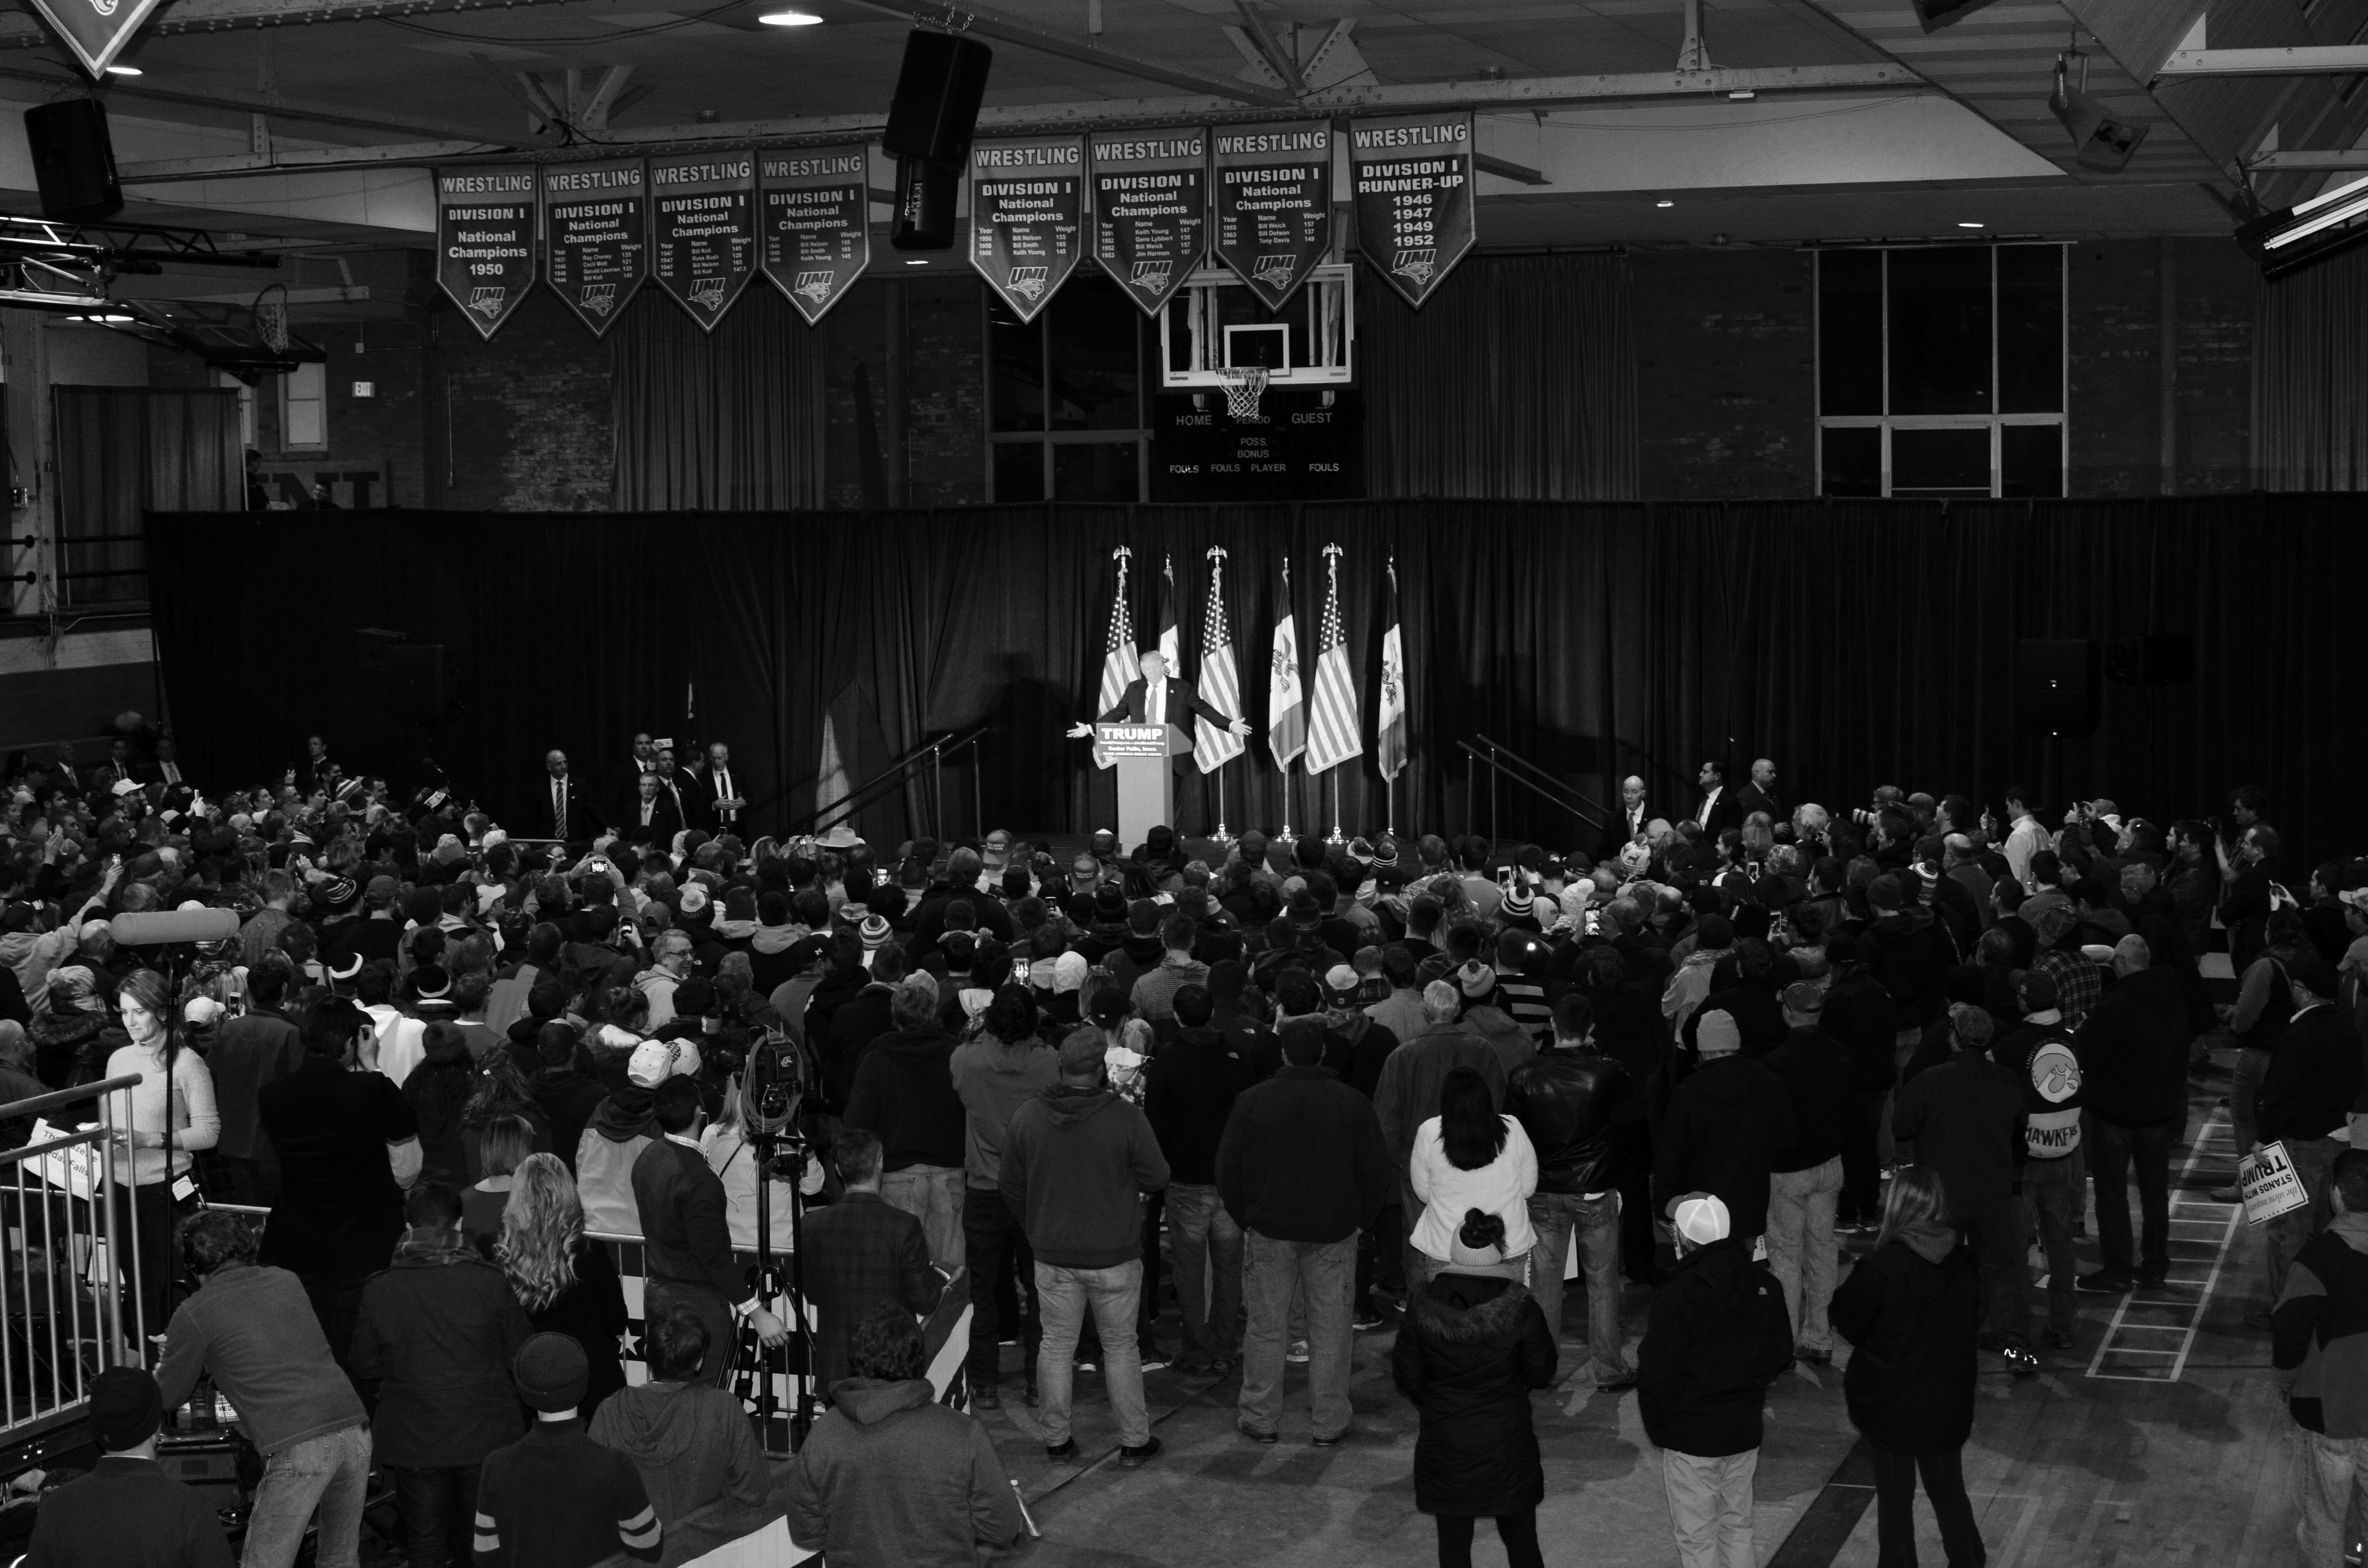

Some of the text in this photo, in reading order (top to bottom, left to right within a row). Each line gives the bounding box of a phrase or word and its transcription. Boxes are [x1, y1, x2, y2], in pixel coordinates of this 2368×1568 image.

[1217, 131, 1326, 154] WRESTLING
[1355, 124, 1466, 148] WRESTLING
[975, 147, 1079, 167] WRESTLING
[1095, 139, 1202, 161] WRESTLING
[654, 161, 751, 184] WRESTLING
[764, 156, 862, 177] WRESTLING
[1363, 159, 1457, 177] DIVISION I
[547, 169, 640, 191] WRESTLING
[1101, 174, 1195, 190] DIVISION I
[1225, 167, 1319, 184] DIVISION I
[442, 176, 531, 192] WRESTLING
[982, 182, 1071, 196] DIVISION I
[1243, 184, 1301, 197] National
[1358, 175, 1464, 193] RUNNER-UP
[662, 195, 744, 212] DIVISION I
[769, 189, 854, 205] DIVISION I
[999, 198, 1054, 209] National
[1120, 191, 1177, 203] National
[1393, 194, 1433, 206] 1946
[555, 202, 634, 219] DIVISION I
[787, 206, 839, 217] National
[1111, 205, 1187, 218] Champions
[1236, 199, 1311, 211] Champions
[449, 208, 524, 220] DIVISION I
[678, 211, 728, 224] National
[992, 212, 1063, 223] Champions
[1303, 211, 1325, 220] Weight
[1393, 208, 1433, 220] 1947
[569, 218, 619, 231] National
[672, 224, 738, 237] Champions
[778, 219, 848, 231] Champions
[1394, 221, 1433, 233] 1949
[458, 231, 516, 242] National
[564, 231, 628, 244] Champions
[1394, 235, 1434, 246] 1952
[449, 246, 527, 260] Champions
[1393, 249, 1436, 271] UNI
[469, 264, 503, 275] 1950
[1131, 260, 1173, 282] UNI
[1254, 255, 1296, 275] UNI
[795, 271, 834, 292] UNI
[1009, 267, 1048, 287] UNI
[580, 283, 616, 304] UNI
[689, 278, 726, 298] UNI
[470, 287, 505, 305] UNI
[1176, 415, 1212, 427] HOME
[1292, 413, 1332, 424] GUEST
[1240, 438, 1269, 447] POSS.
[1237, 450, 1270, 459] BONUS
[1170, 463, 1339, 473] FOULS FOULS PLAYER FOULS
[1101, 728, 1163, 740] TRUMP
[2242, 1155, 2288, 1187] TRUMP
[2244, 1174, 2293, 1201] STANDS WITH
